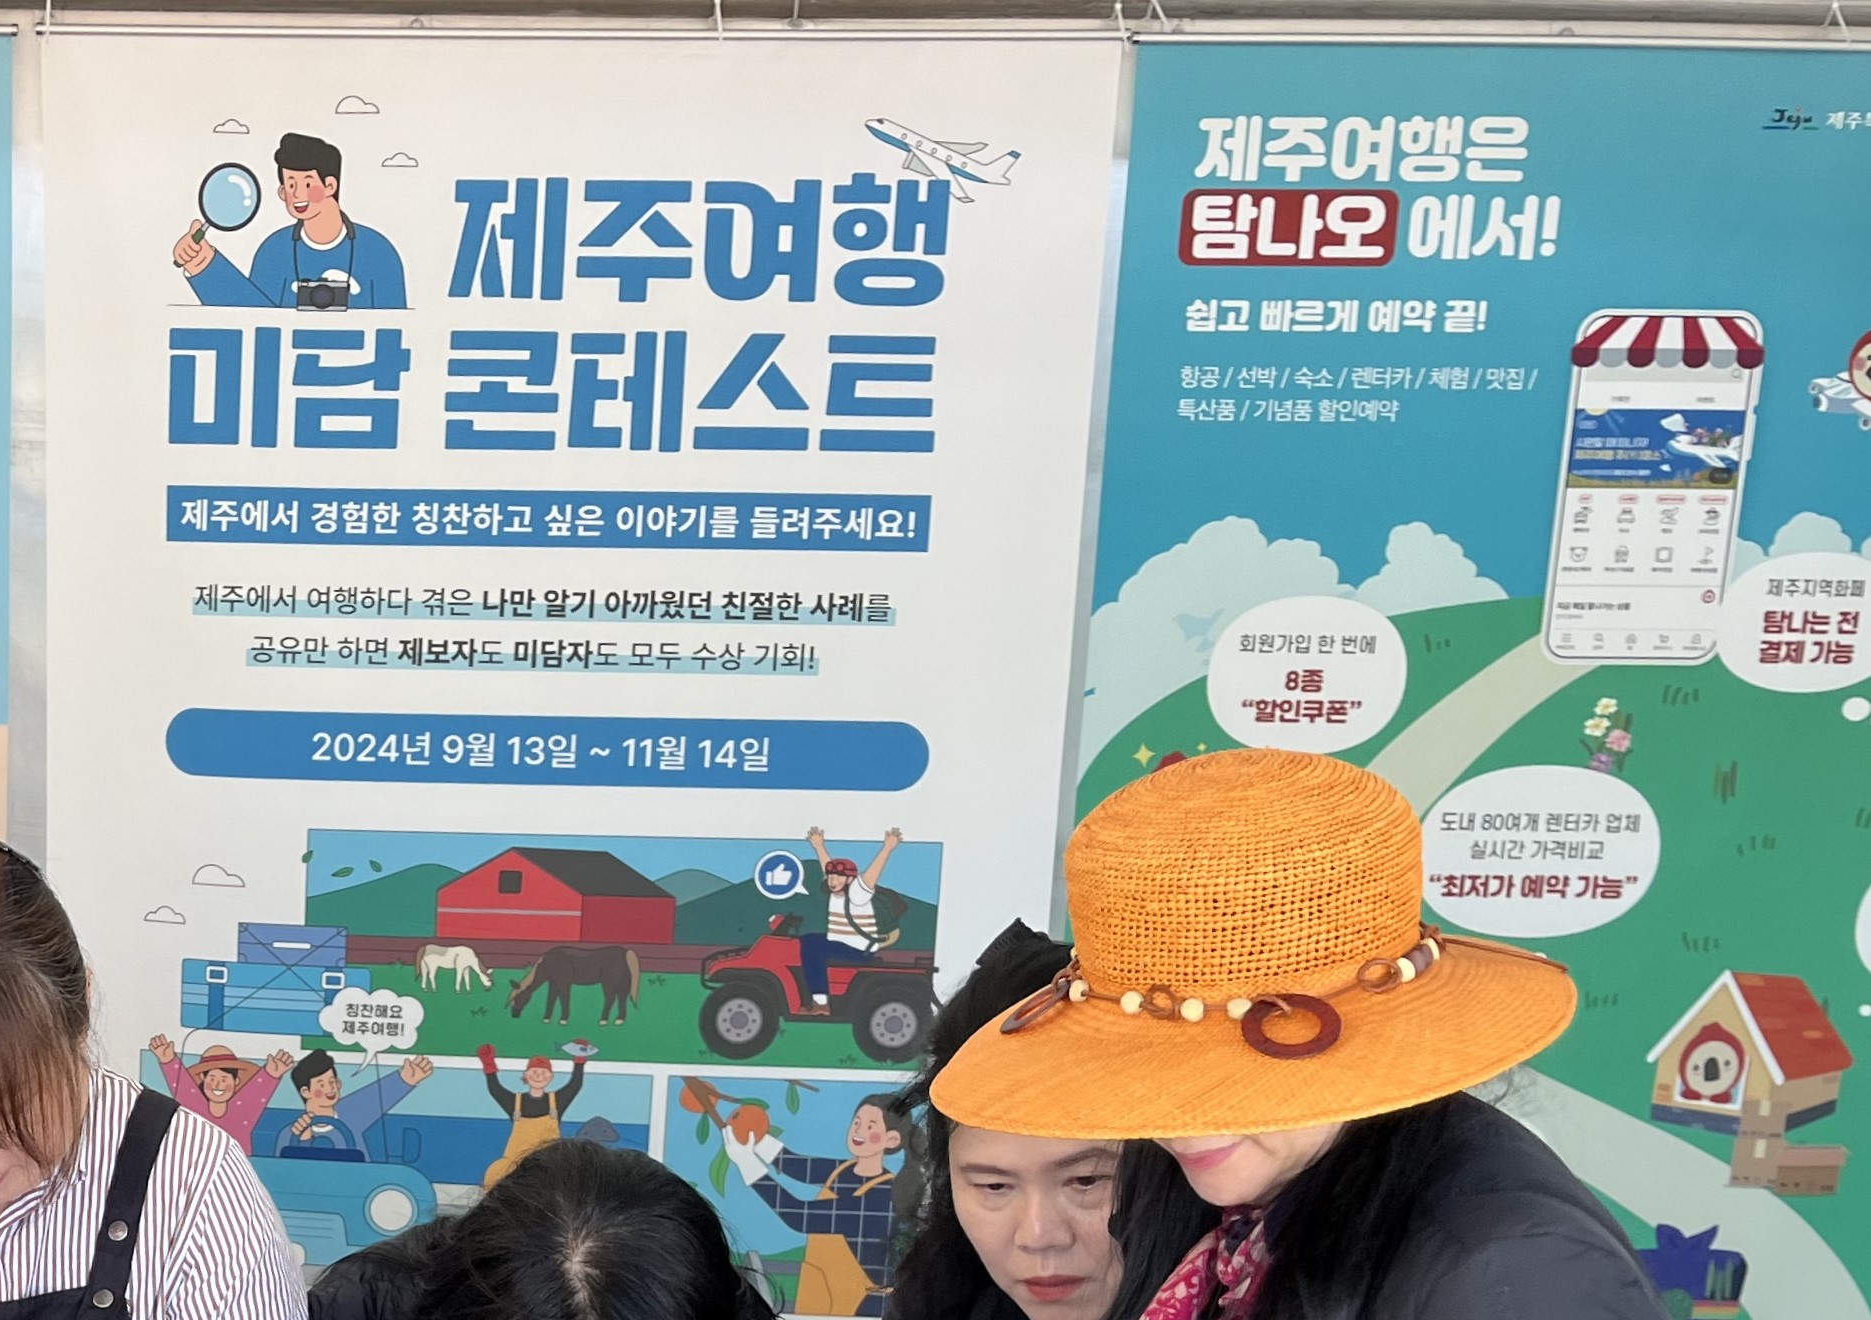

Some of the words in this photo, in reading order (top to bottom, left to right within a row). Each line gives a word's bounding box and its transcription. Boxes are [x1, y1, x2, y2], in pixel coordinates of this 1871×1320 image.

[1193, 115, 1530, 182] 제주여행은
[447, 172, 952, 307] 제주여행
[1190, 193, 1387, 259] 탐나오
[1409, 194, 1561, 261] 에서!
[1186, 300, 1250, 332] 쉽고
[1260, 300, 1359, 333] 빠르게
[1368, 300, 1437, 334] 예약
[1444, 300, 1487, 333] 끝!
[168, 325, 411, 450] 미담
[444, 329, 937, 453] 콘테스트
[1180, 365, 1220, 388] 항공
[1237, 366, 1277, 389] 선박
[1293, 367, 1334, 389] 숙소
[1351, 368, 1413, 390] 렌터카
[1428, 368, 1470, 391] 체험
[1486, 368, 1526, 392] 맛집
[1177, 400, 1236, 421] 특산품
[1254, 400, 1314, 422] 기념품
[1318, 400, 1400, 422] 할인예약
[180, 499, 300, 534] 제주에서
[310, 501, 401, 536] 경험한
[411, 502, 532, 536] 칭찬하고
[544, 503, 605, 538] 싶은
[616, 504, 739, 540] 이야기를
[749, 506, 916, 542] 들려주세요!
[194, 583, 298, 615] 제주에서
[306, 585, 412, 616] 여행하다
[421, 588, 474, 618] 겪은
[481, 589, 536, 618] 나만
[542, 590, 596, 619] 알기
[603, 591, 712, 621] 아까웠던
[720, 592, 801, 623] 친절한
[810, 593, 892, 624] 사례를
[1762, 610, 1831, 634] 탐나는
[1837, 610, 1860, 634] 전
[250, 635, 329, 667] 공유만
[337, 636, 390, 667] 하면
[398, 637, 504, 668] 제보자도
[513, 638, 619, 669] 미담자도
[628, 640, 681, 671] 모두
[691, 641, 745, 672] 수상
[753, 642, 815, 673] 기회!
[1239, 632, 1313, 655] 회원가입
[1319, 633, 1337, 655] 한
[1341, 634, 1377, 656] 번에
[1759, 640, 1805, 664] 결제
[1810, 641, 1855, 664] 가능
[1284, 669, 1324, 694] 8종
[312, 731, 432, 768] 2024년
[442, 734, 496, 768] 9월
[507, 735, 578, 770] 13일
[622, 735, 688, 770] 11월
[698, 736, 770, 772] 14일
[1441, 811, 1476, 832] 도내
[1481, 812, 1540, 832] 80여개
[1545, 812, 1600, 833] 렌터카
[1605, 813, 1641, 834] 업체
[1470, 839, 1526, 860] 실시간
[1531, 839, 1605, 861] 가격비교
[1521, 876, 1571, 899] 예약
[346, 1003, 403, 1019] 칭찬해요
[342, 1020, 405, 1037] 제주여행!
